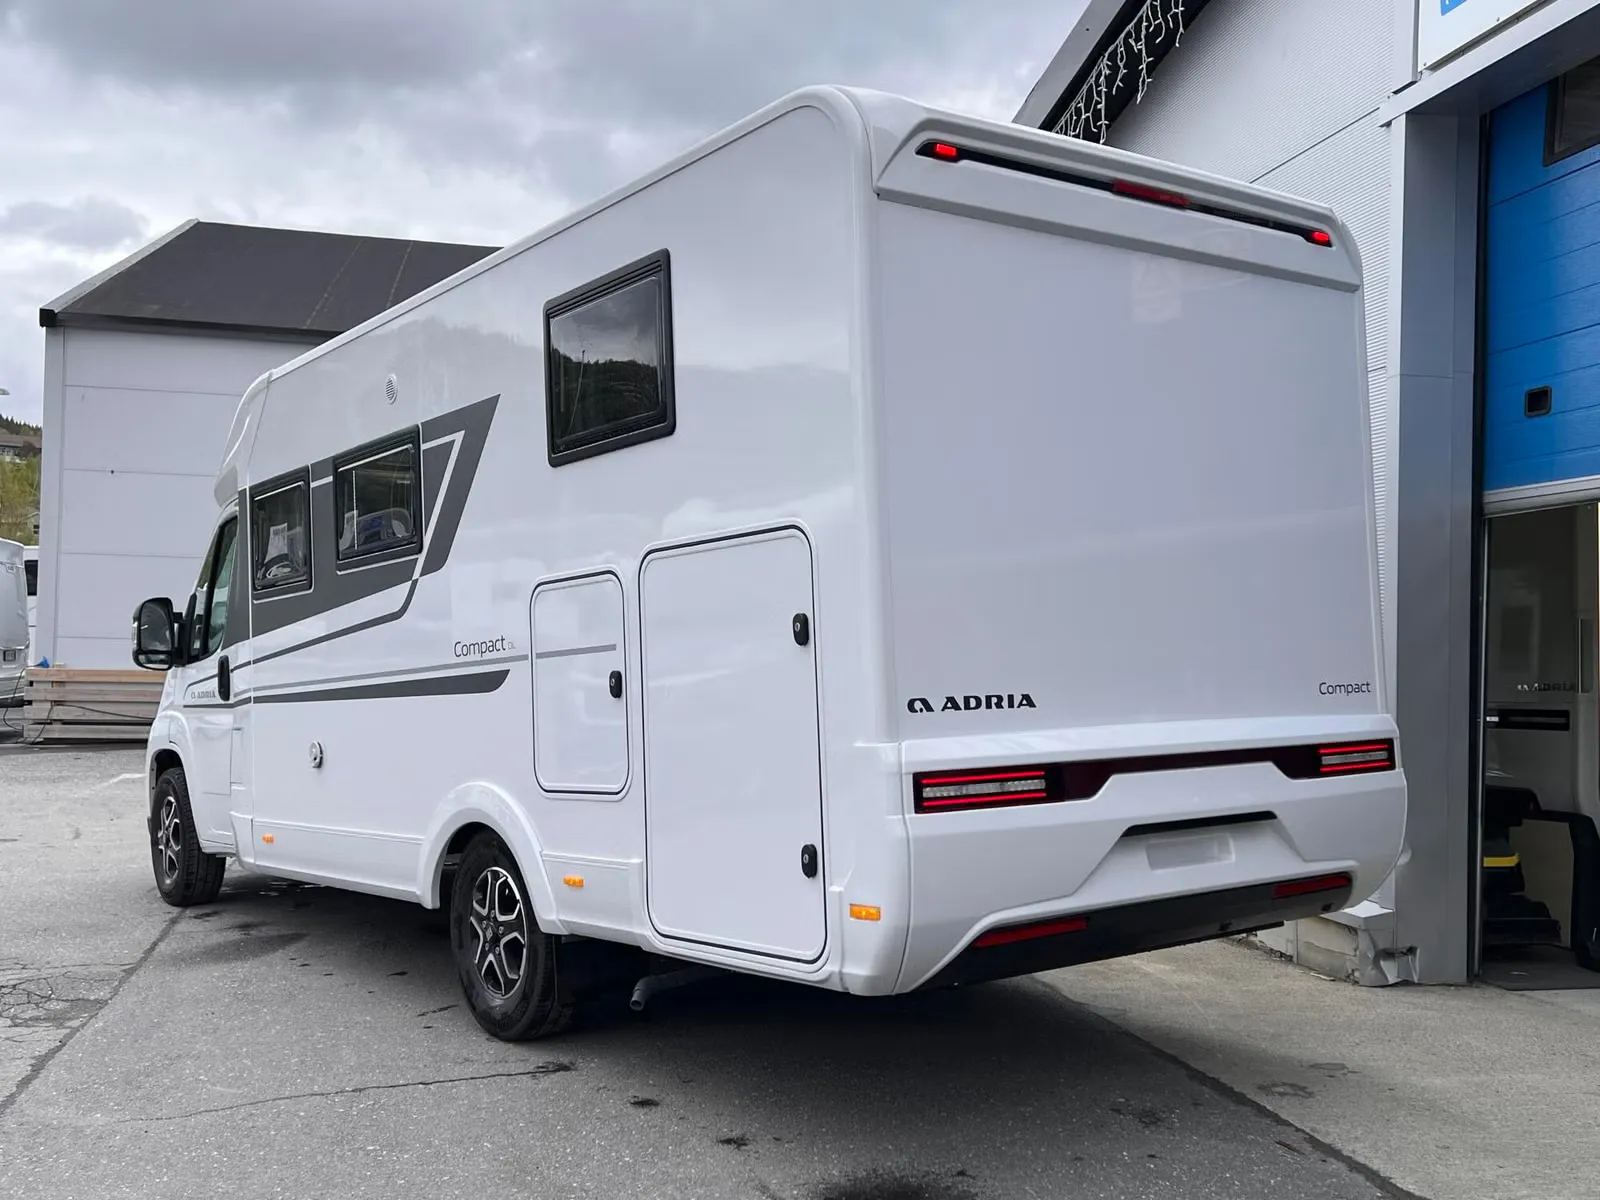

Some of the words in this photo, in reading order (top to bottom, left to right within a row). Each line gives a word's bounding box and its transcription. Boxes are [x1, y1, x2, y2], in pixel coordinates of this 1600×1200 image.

[453, 634, 507, 658] Compact
[1318, 680, 1372, 697] Compact
[940, 693, 1037, 712] ADRIA
